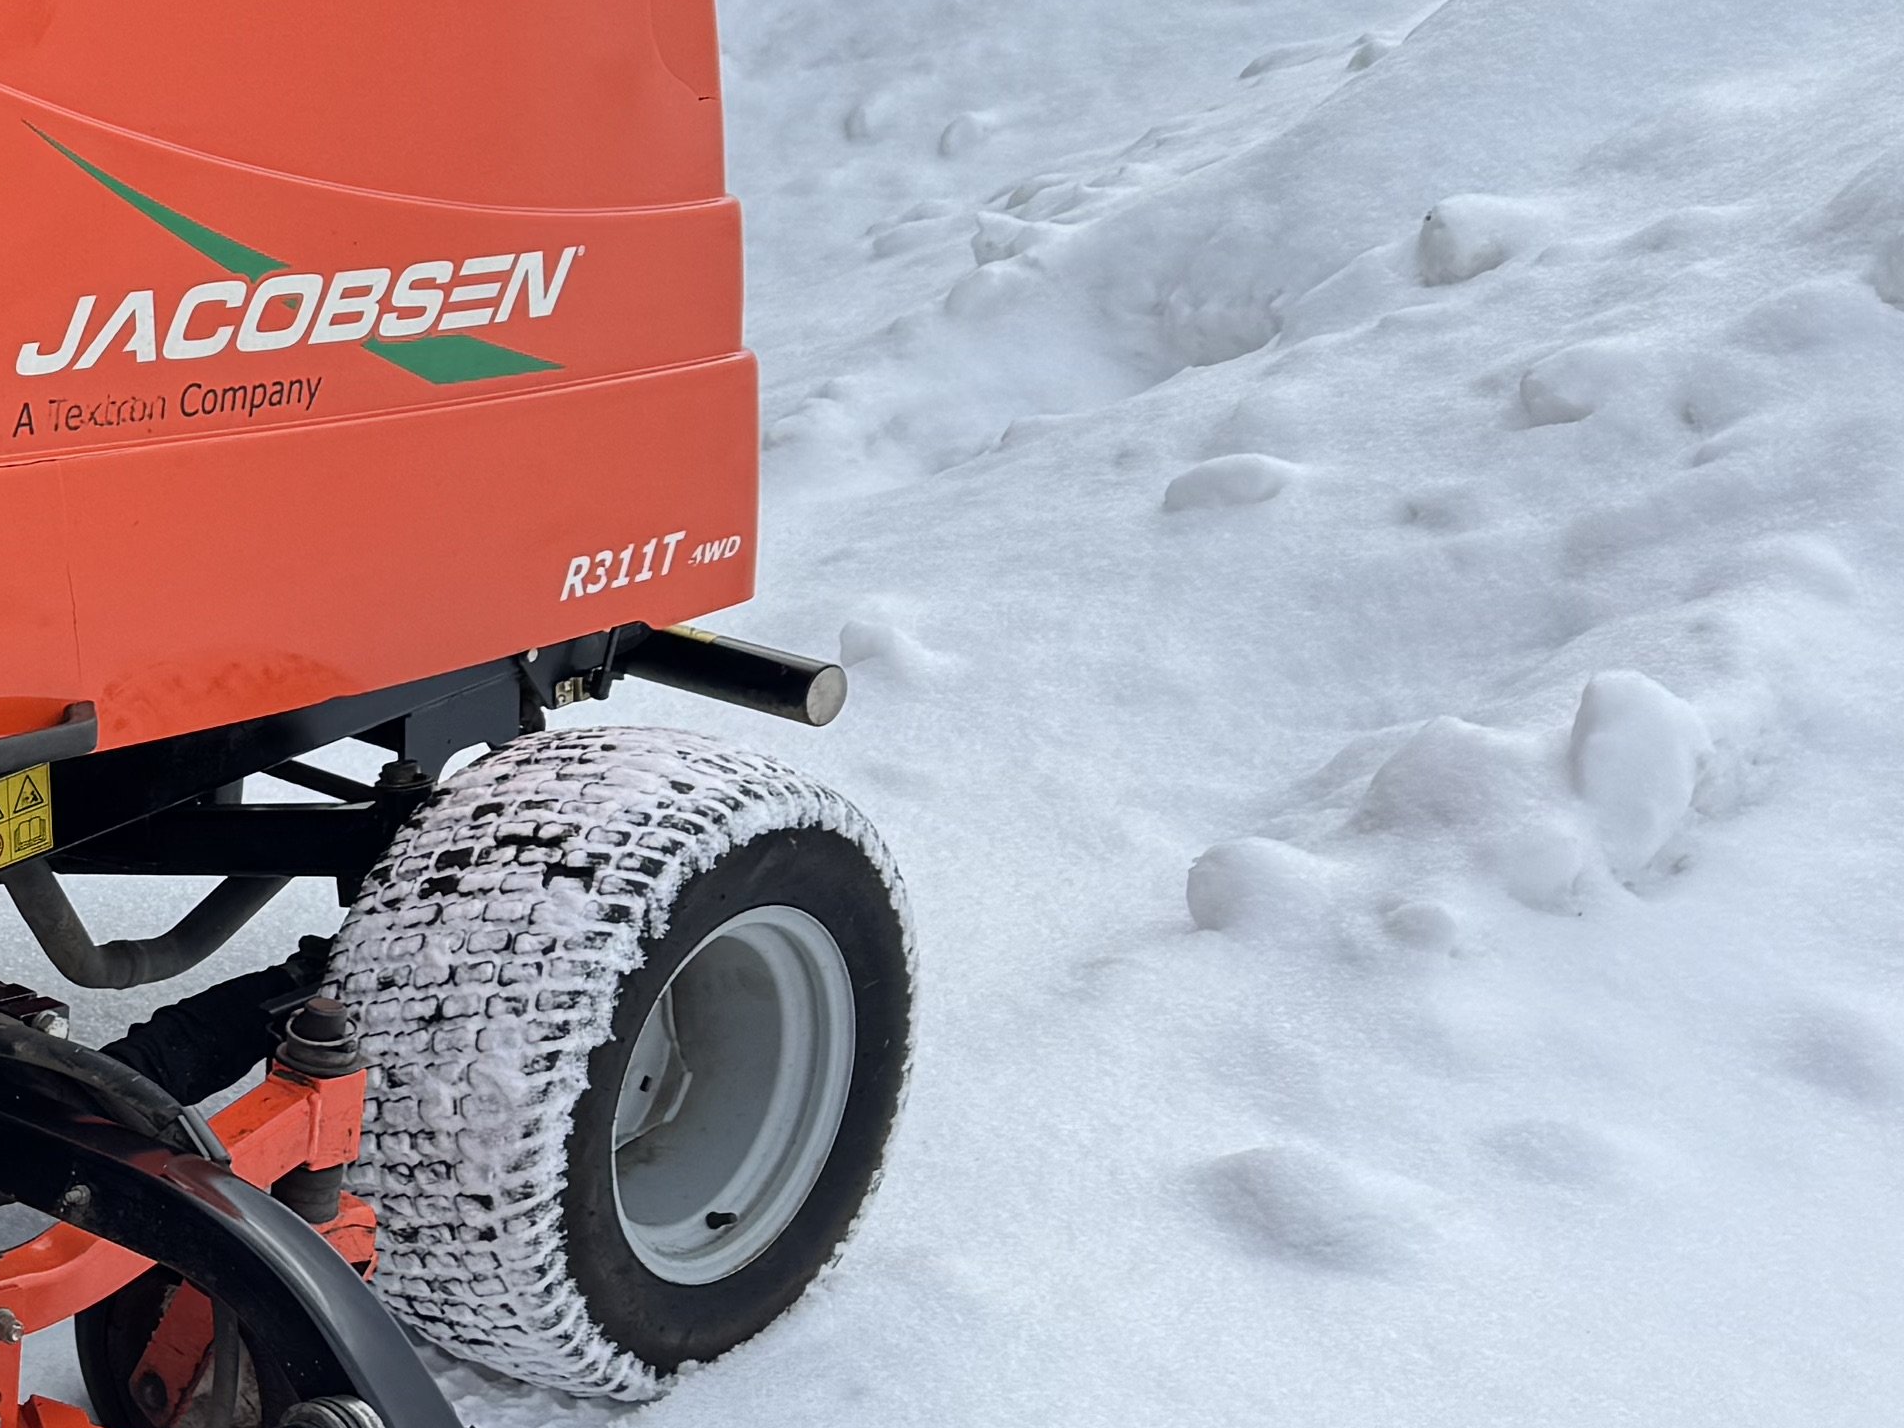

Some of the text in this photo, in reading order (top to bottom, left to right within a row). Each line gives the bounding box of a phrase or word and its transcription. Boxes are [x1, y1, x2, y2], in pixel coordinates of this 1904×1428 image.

[16, 246, 579, 377] JACOBSEN
[13, 375, 323, 439] A Textron Company
[559, 531, 686, 602] R311T
